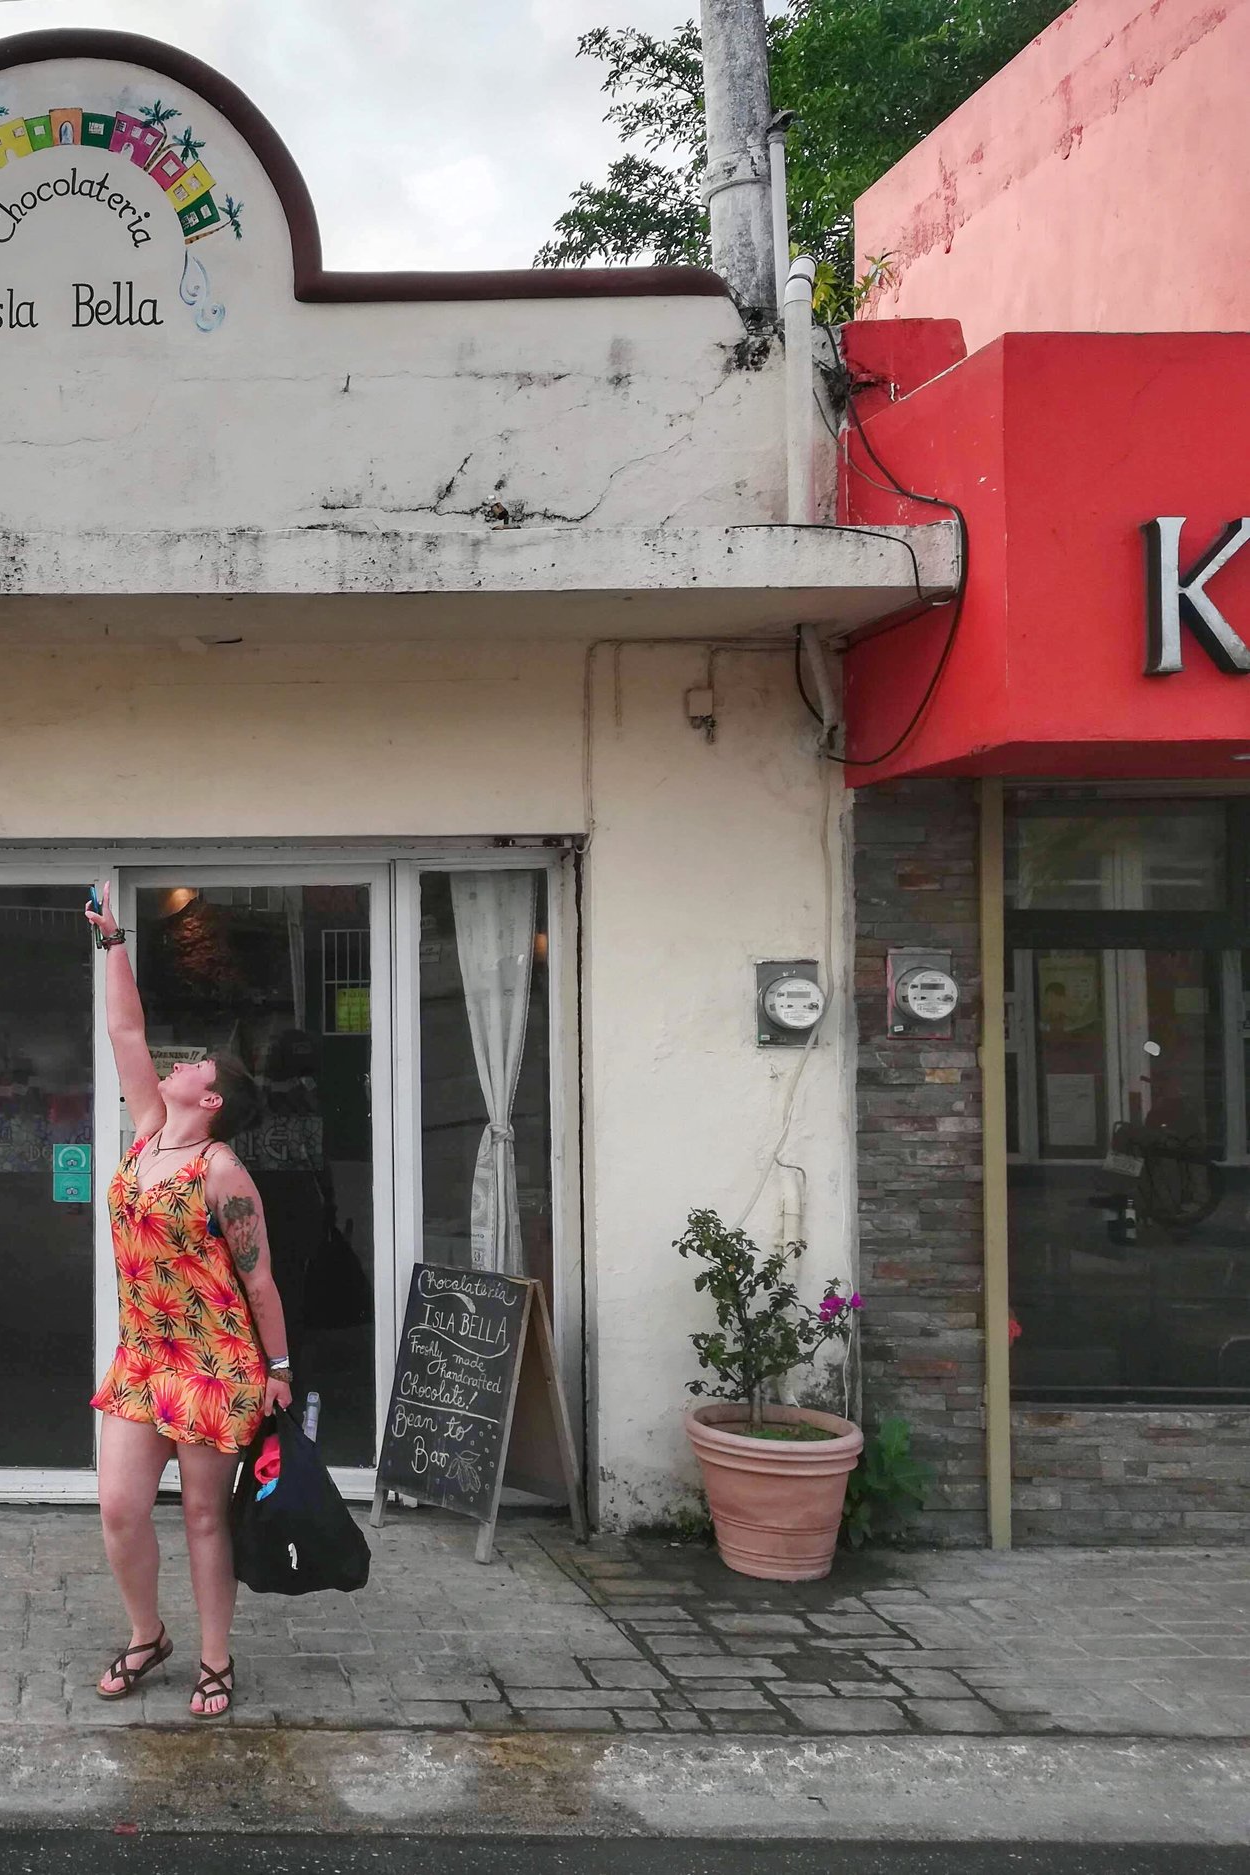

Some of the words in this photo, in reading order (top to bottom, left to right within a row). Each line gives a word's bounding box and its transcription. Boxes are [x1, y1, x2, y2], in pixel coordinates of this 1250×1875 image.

[72, 282, 164, 328] Bella
[419, 1303, 455, 1333] ISLA
[459, 1313, 507, 1346] BELLA
[411, 1335, 448, 1375] Freshly
[452, 1354, 486, 1372] made
[440, 1363, 502, 1394] handcrafted
[392, 1404, 438, 1438] Bean
[444, 1416, 473, 1442] to
[411, 1435, 450, 1473] Bar
